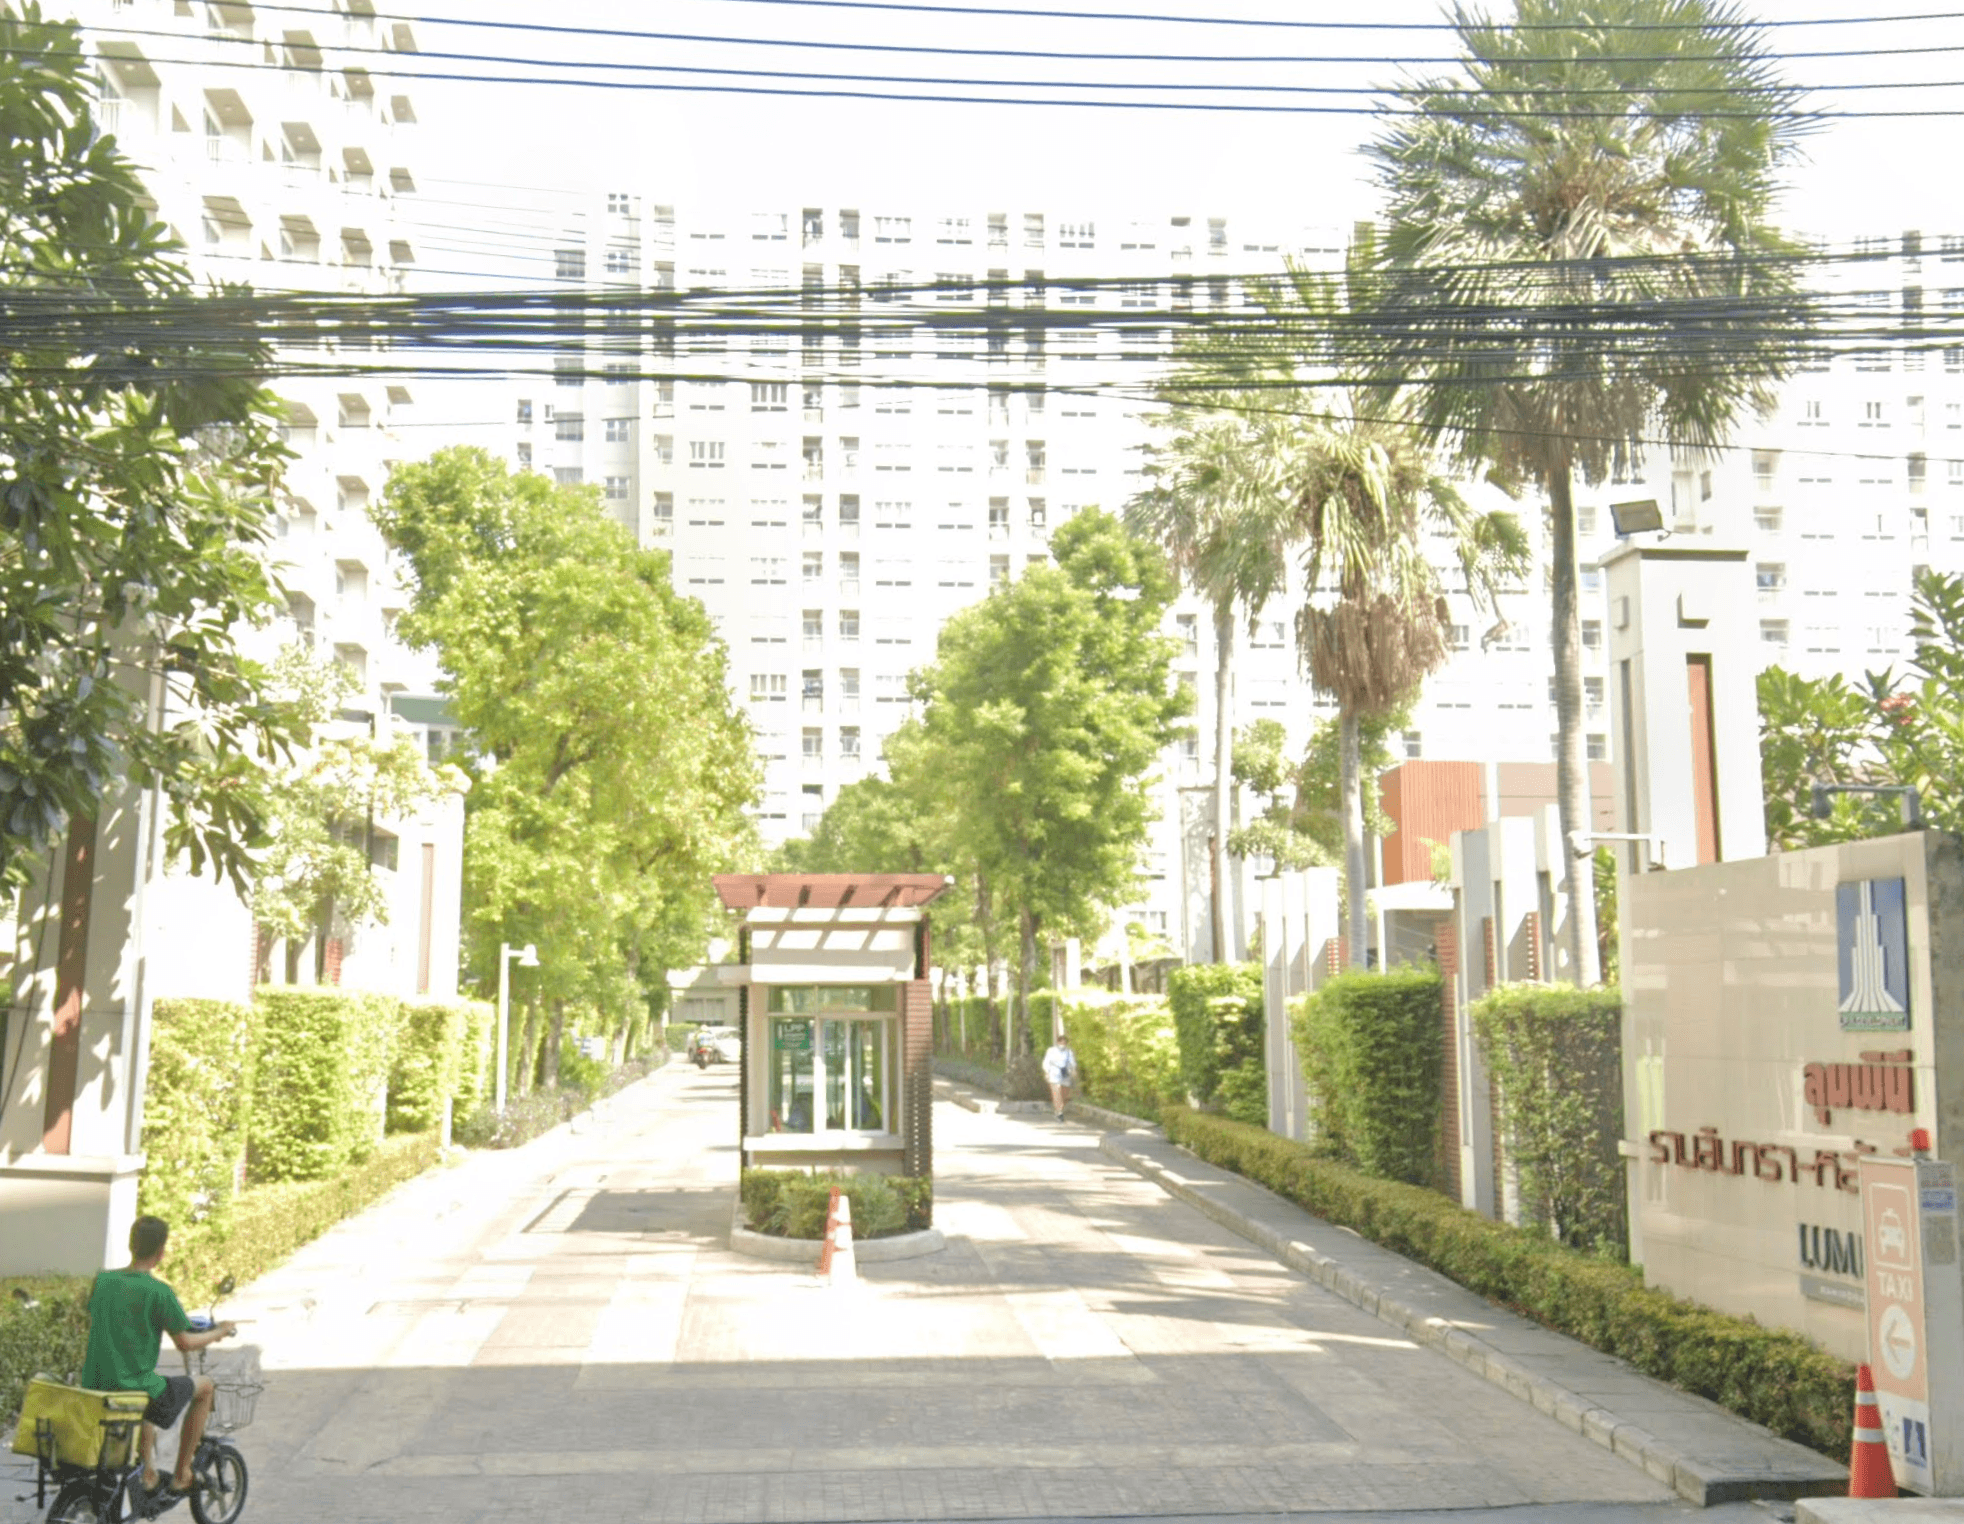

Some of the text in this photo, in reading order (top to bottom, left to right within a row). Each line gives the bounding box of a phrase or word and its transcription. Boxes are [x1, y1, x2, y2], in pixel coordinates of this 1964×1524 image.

[1803, 1049, 1914, 1127] ลุมพินี
[1875, 1270, 1914, 1302] TAXI
